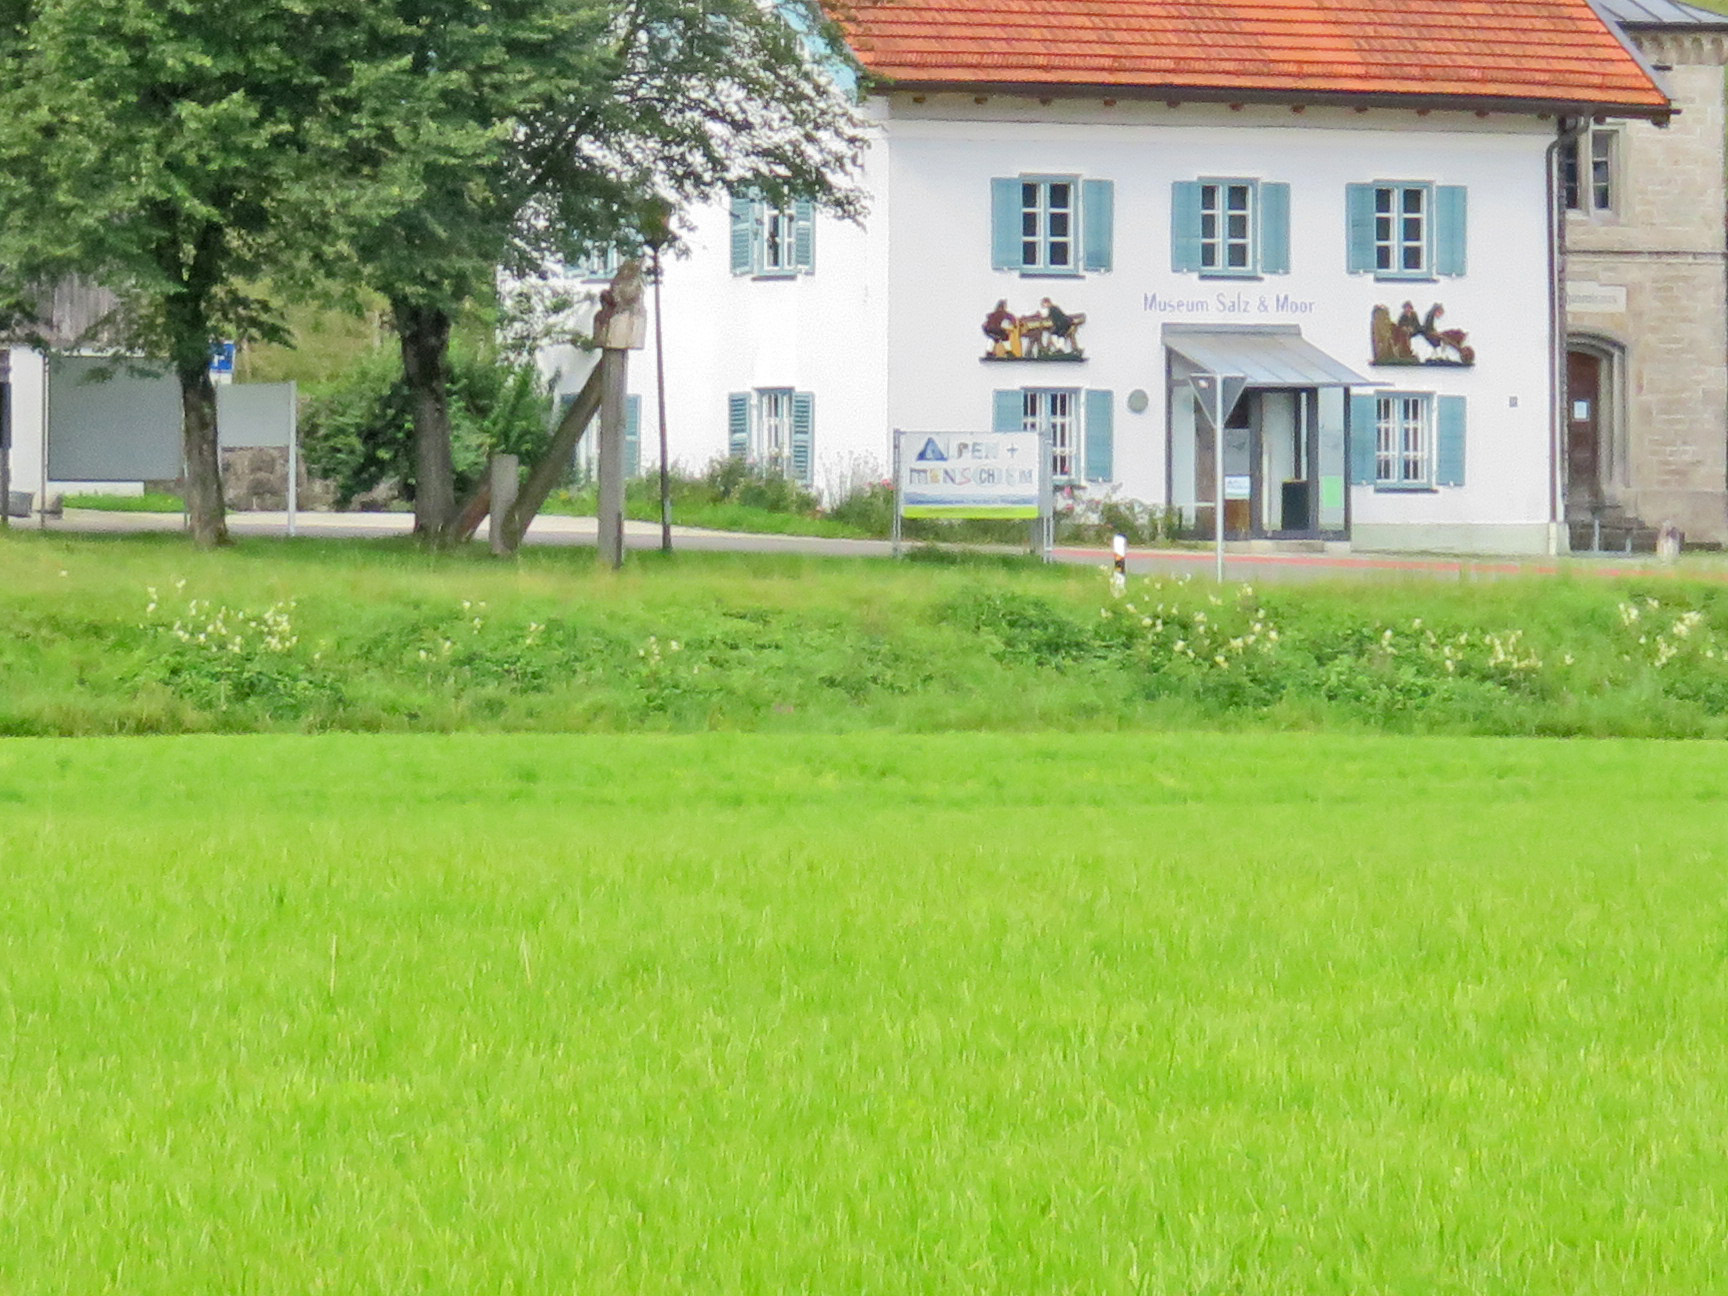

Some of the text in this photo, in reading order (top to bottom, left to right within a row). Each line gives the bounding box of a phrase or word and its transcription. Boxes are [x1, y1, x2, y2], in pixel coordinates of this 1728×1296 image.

[1143, 291, 1315, 313] Museum Salz & Moor
